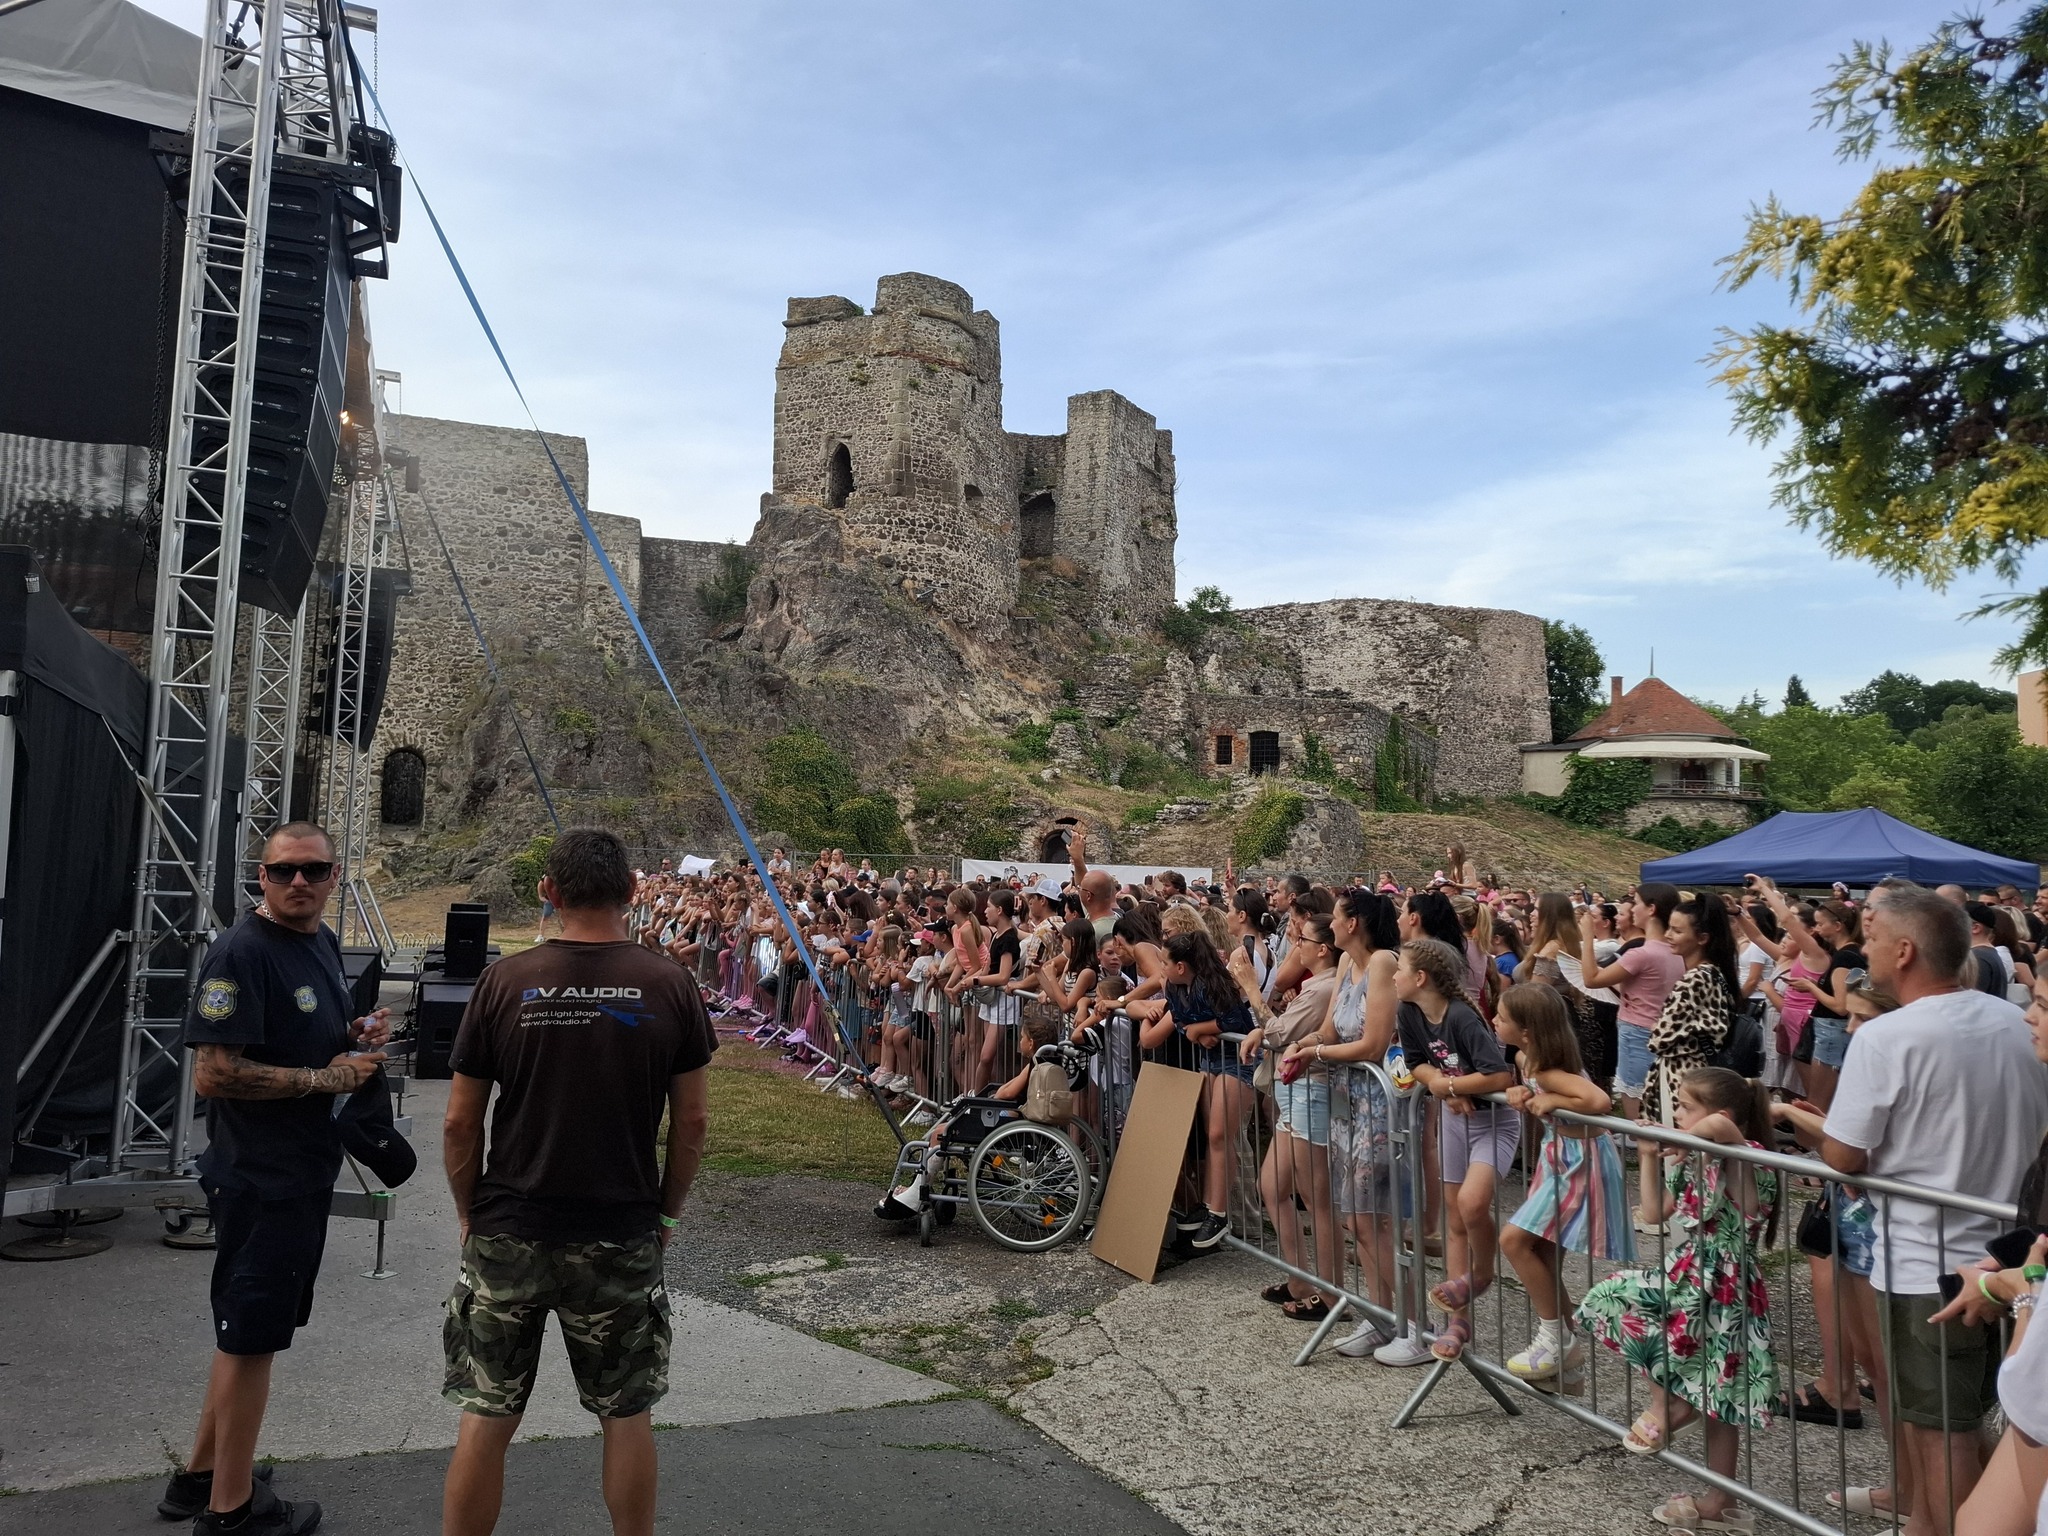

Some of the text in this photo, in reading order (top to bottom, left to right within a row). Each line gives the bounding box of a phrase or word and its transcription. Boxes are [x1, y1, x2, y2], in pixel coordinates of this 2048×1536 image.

[522, 987, 642, 1001] DV AUDIO
[520, 1018, 592, 1028] www.dvaudio.sk
